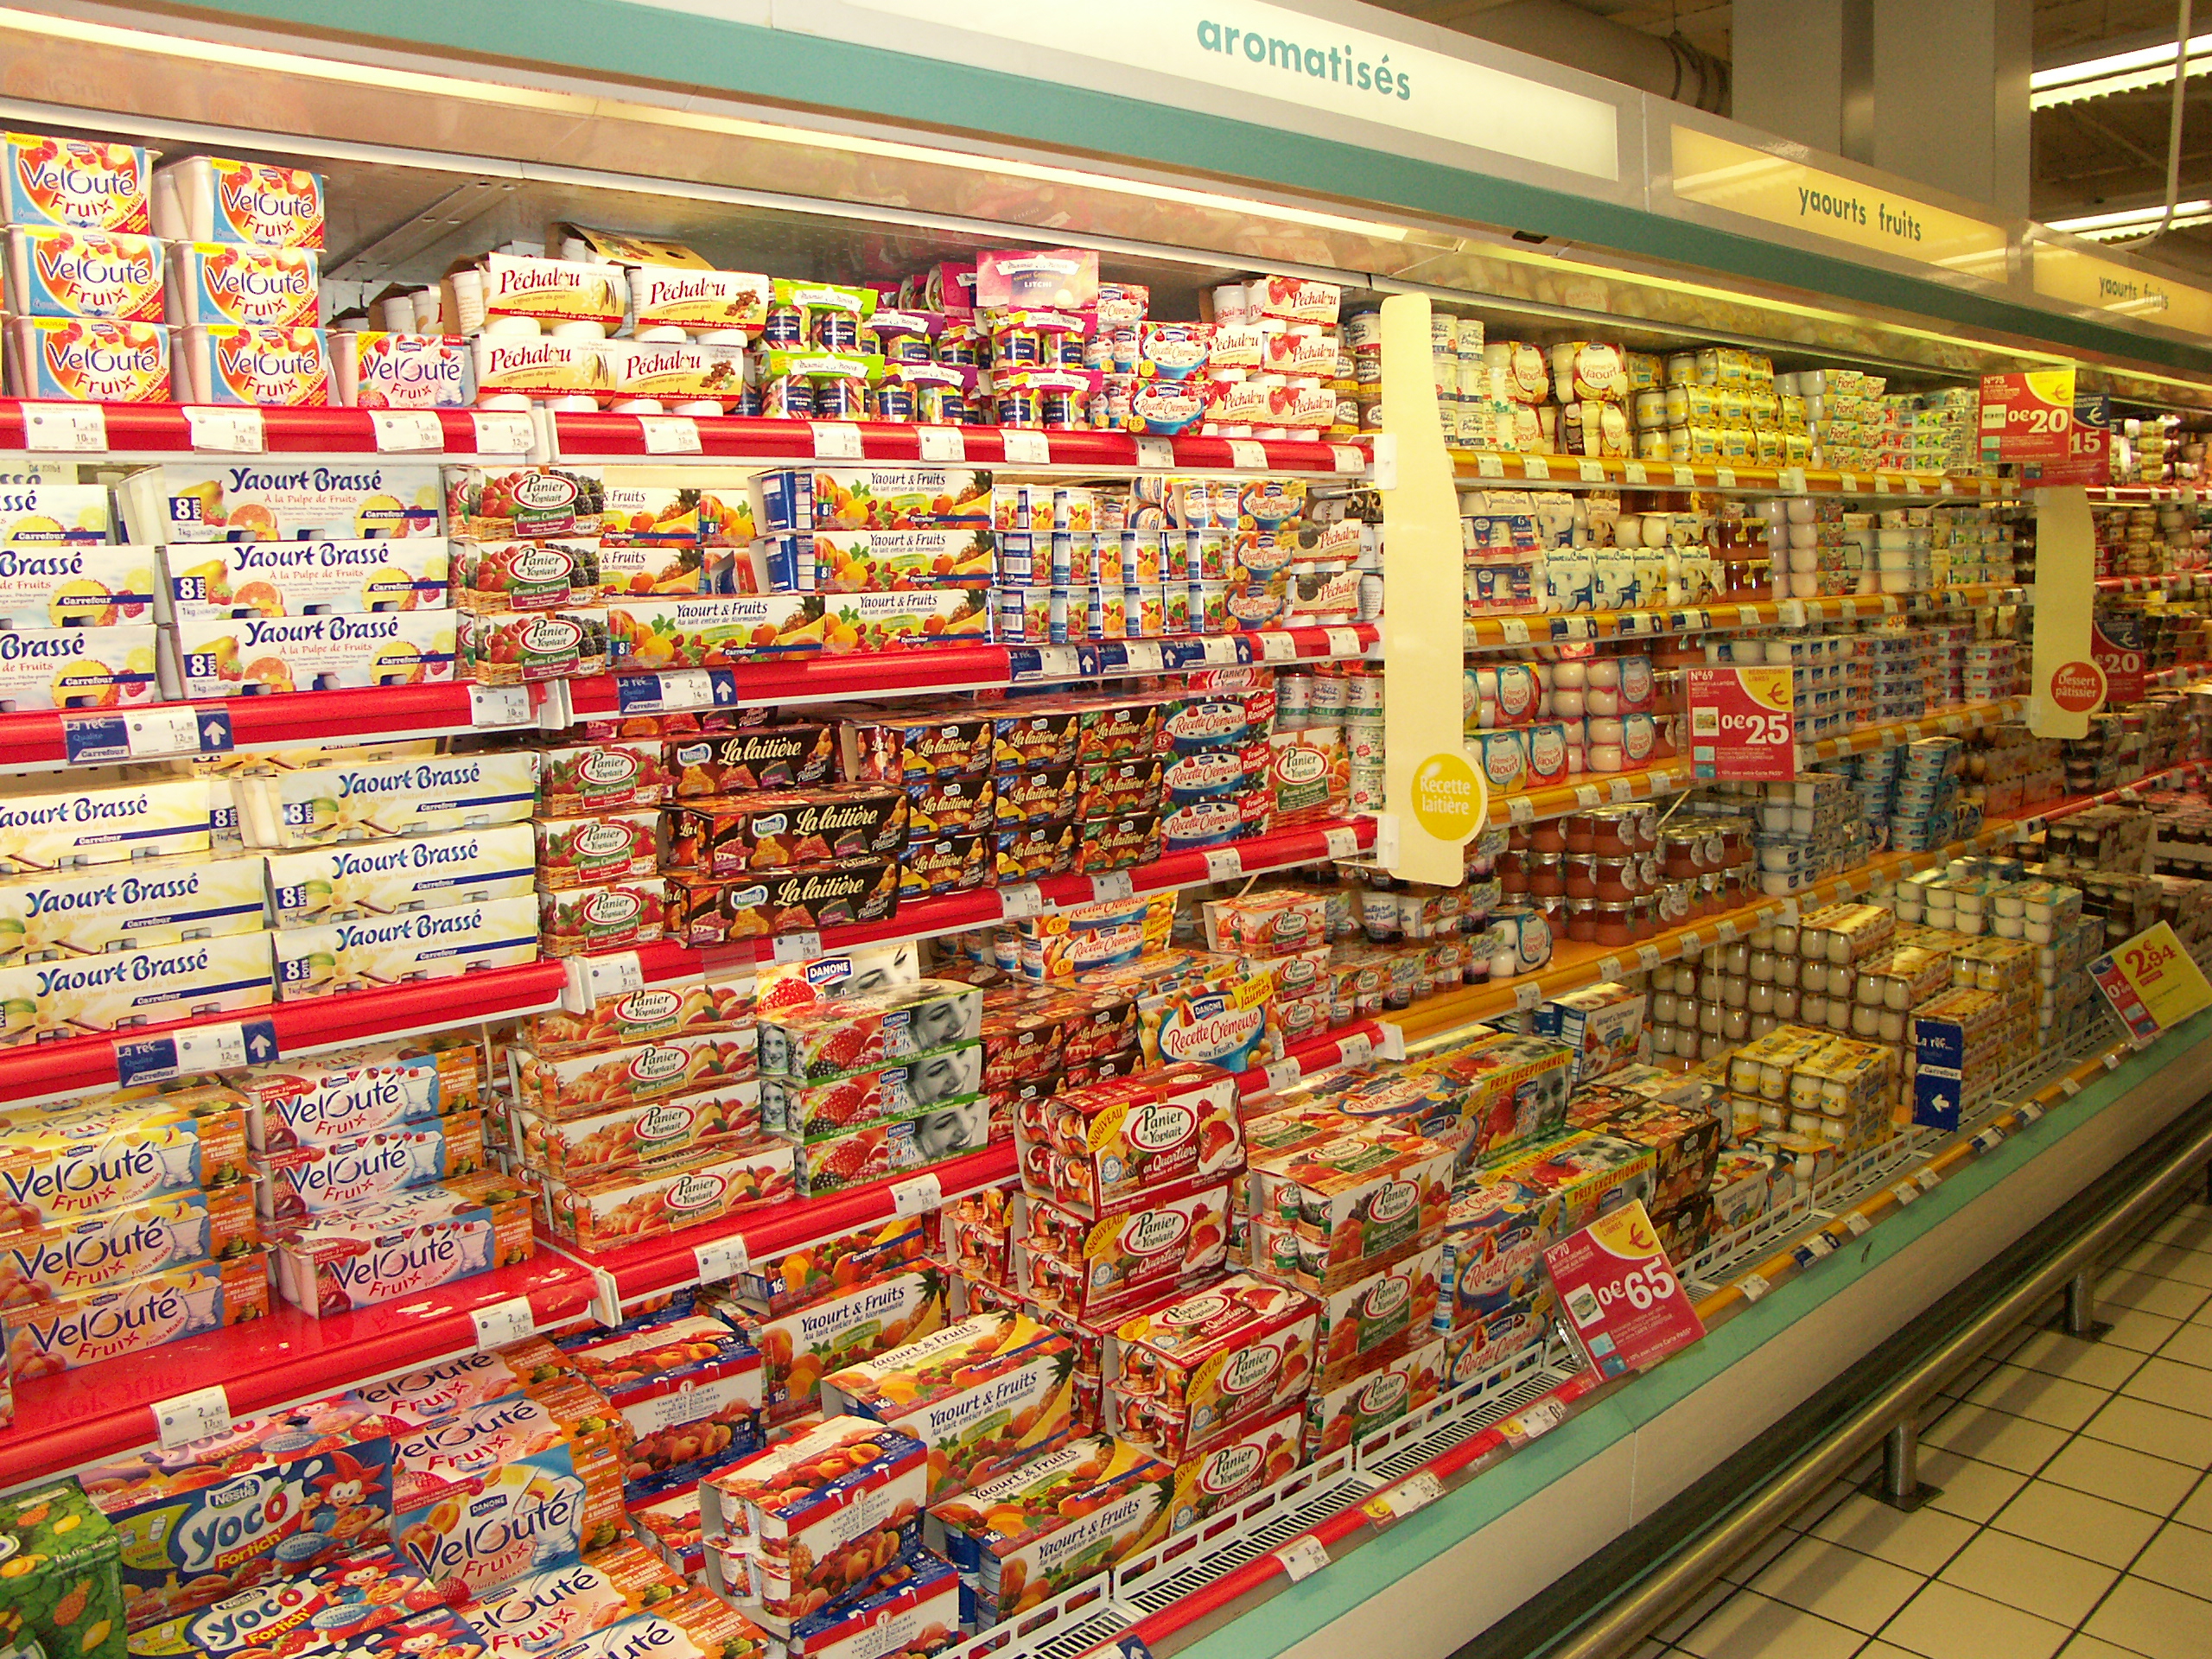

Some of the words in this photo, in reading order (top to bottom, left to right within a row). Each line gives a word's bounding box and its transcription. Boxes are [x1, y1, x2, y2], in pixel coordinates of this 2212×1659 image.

[1198, 20, 1411, 100] aromatisés
[50, 189, 114, 219] Fruix
[1798, 186, 1866, 226] yaourts
[1878, 204, 1922, 242] fruits
[243, 213, 297, 238] Fruix
[498, 267, 582, 296] Péchalou
[648, 277, 727, 306] Péchalou
[1024, 280, 1052, 289] LITCHI
[2099, 275, 2138, 301] yaourts
[487, 343, 573, 375] Péchalou
[74, 372, 137, 398] Fruix
[244, 375, 300, 399] Fruix
[390, 382, 433, 399] Fruix
[230, 467, 311, 493] Yaourt
[314, 467, 384, 493] Brassé
[525, 474, 566, 495] Panier
[871, 472, 906, 486] Yaourt
[907, 474, 916, 485] &
[917, 472, 946, 486] Fruits
[175, 498, 192, 519] 8
[275, 495, 285, 504] la
[288, 495, 315, 506] Pulpe
[316, 495, 327, 505] de
[330, 495, 358, 505] Fruits
[531, 492, 563, 505] Yoplait
[365, 509, 406, 519] Carrefour
[234, 544, 315, 571] Yaourt
[319, 542, 390, 566] Brassé
[372, 582, 414, 591] Carrefour
[677, 603, 719, 619] Yaourt
[721, 606, 730, 616] &
[732, 601, 768, 616] Fruits
[860, 595, 896, 609] Yaourt
[898, 595, 905, 607] &
[907, 594, 938, 607] Fruits
[245, 620, 326, 647] Yaourt
[328, 615, 400, 640] Brassé
[532, 619, 571, 638] Panier
[2, 633, 86, 659] Brassé
[537, 636, 567, 648] Yoplait
[190, 654, 206, 677] 8
[1690, 671, 1713, 681] N°69
[65, 675, 114, 688] Carrefour
[2057, 674, 2095, 687] Dessert
[2055, 686, 2097, 699] pâtissier
[1247, 707, 1275, 721] Rouges
[1250, 698, 1274, 712] Fruits
[1174, 716, 1207, 734] Recette
[1721, 713, 1789, 745] 0€25
[80, 748, 126, 759] Carrefour
[591, 752, 626, 771] Panier
[718, 737, 742, 766] La
[741, 736, 802, 760] laitière
[596, 768, 625, 779] Yoplait
[1285, 753, 1319, 772] Panier
[339, 771, 412, 798] Yaourt
[416, 760, 481, 790] Brassé
[1420, 775, 1471, 795] Recette
[73, 792, 149, 821] Brassé
[289, 804, 304, 824] 8
[419, 800, 458, 812] Carrefour
[1421, 793, 1470, 815] laitière
[791, 808, 817, 836] La
[815, 804, 879, 830] laitière
[24, 887, 117, 918] Yaourt
[121, 872, 200, 905] Brassé
[773, 878, 799, 906] La
[797, 874, 865, 901] laitière
[597, 893, 632, 912] Panier
[127, 916, 173, 928] Carrefour
[601, 907, 628, 922] Yoplait
[335, 923, 413, 952] Yaourt
[416, 908, 484, 939] Brassé
[35, 965, 128, 997] Yaourt
[132, 947, 210, 982] Brassé
[809, 961, 849, 978] DANONE
[1242, 977, 1266, 995] Fruits
[629, 989, 673, 1009] Panier
[1194, 1000, 1223, 1016] DANONE
[1240, 986, 1271, 1009] Jaunes
[633, 1005, 669, 1019] Yoplait
[1168, 1029, 1211, 1054] Recette
[1211, 1012, 1260, 1045] Crémeuse
[1490, 1073, 1509, 1090] PRIX
[1510, 1052, 1566, 1085] EXCEPTIONNEL
[1924, 1065, 1959, 1078] Carrefour
[315, 1111, 367, 1136] Fruix
[1139, 1104, 1183, 1129] Panier
[1090, 1107, 1124, 1149] NOUVEAU
[1148, 1127, 1182, 1144] Yoplait
[1152, 1144, 1198, 1170] Quartiers
[677, 1175, 718, 1195] Panier
[49, 1185, 118, 1212] Fruix
[682, 1188, 715, 1206] Yoplait
[1547, 1243, 1570, 1263] N°70
[368, 1270, 423, 1297] Fruix
[1598, 1256, 1675, 1310] 0€65
[800, 1305, 850, 1333] Yaourt
[852, 1301, 863, 1316] &
[865, 1286, 905, 1312] Fruits
[75, 1331, 139, 1360] Fruix
[1232, 1349, 1272, 1374] Panier
[1237, 1364, 1268, 1386] Yoplait
[928, 1395, 980, 1428] Yaourt
[982, 1390, 994, 1407] &
[995, 1370, 1038, 1401] Fruits
[213, 1484, 257, 1506] Nestlé
[472, 1496, 506, 1514] DANONE
[1038, 1522, 1086, 1560] Yaourt
[1088, 1519, 1099, 1535] &
[1100, 1497, 1141, 1529] Fruits
[461, 1542, 531, 1578] Fruix
